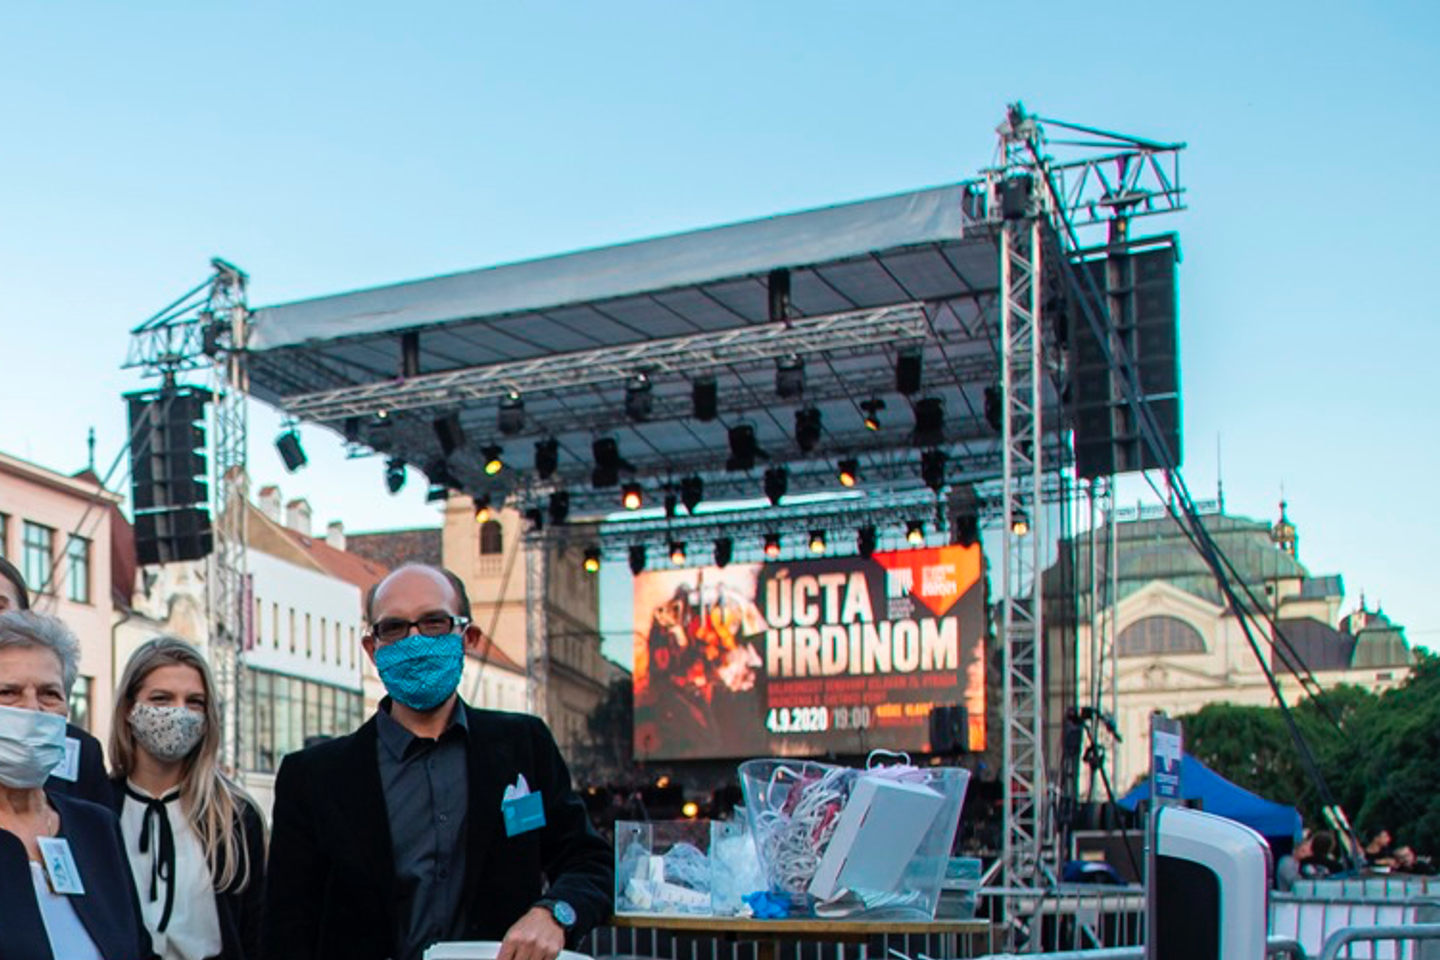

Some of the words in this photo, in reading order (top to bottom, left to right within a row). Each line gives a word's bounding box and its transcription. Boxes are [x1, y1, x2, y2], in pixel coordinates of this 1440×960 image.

[766, 568, 874, 628] ÚCTA
[766, 616, 958, 677] HRDINOM
[767, 706, 828, 732] 4.9.2020
